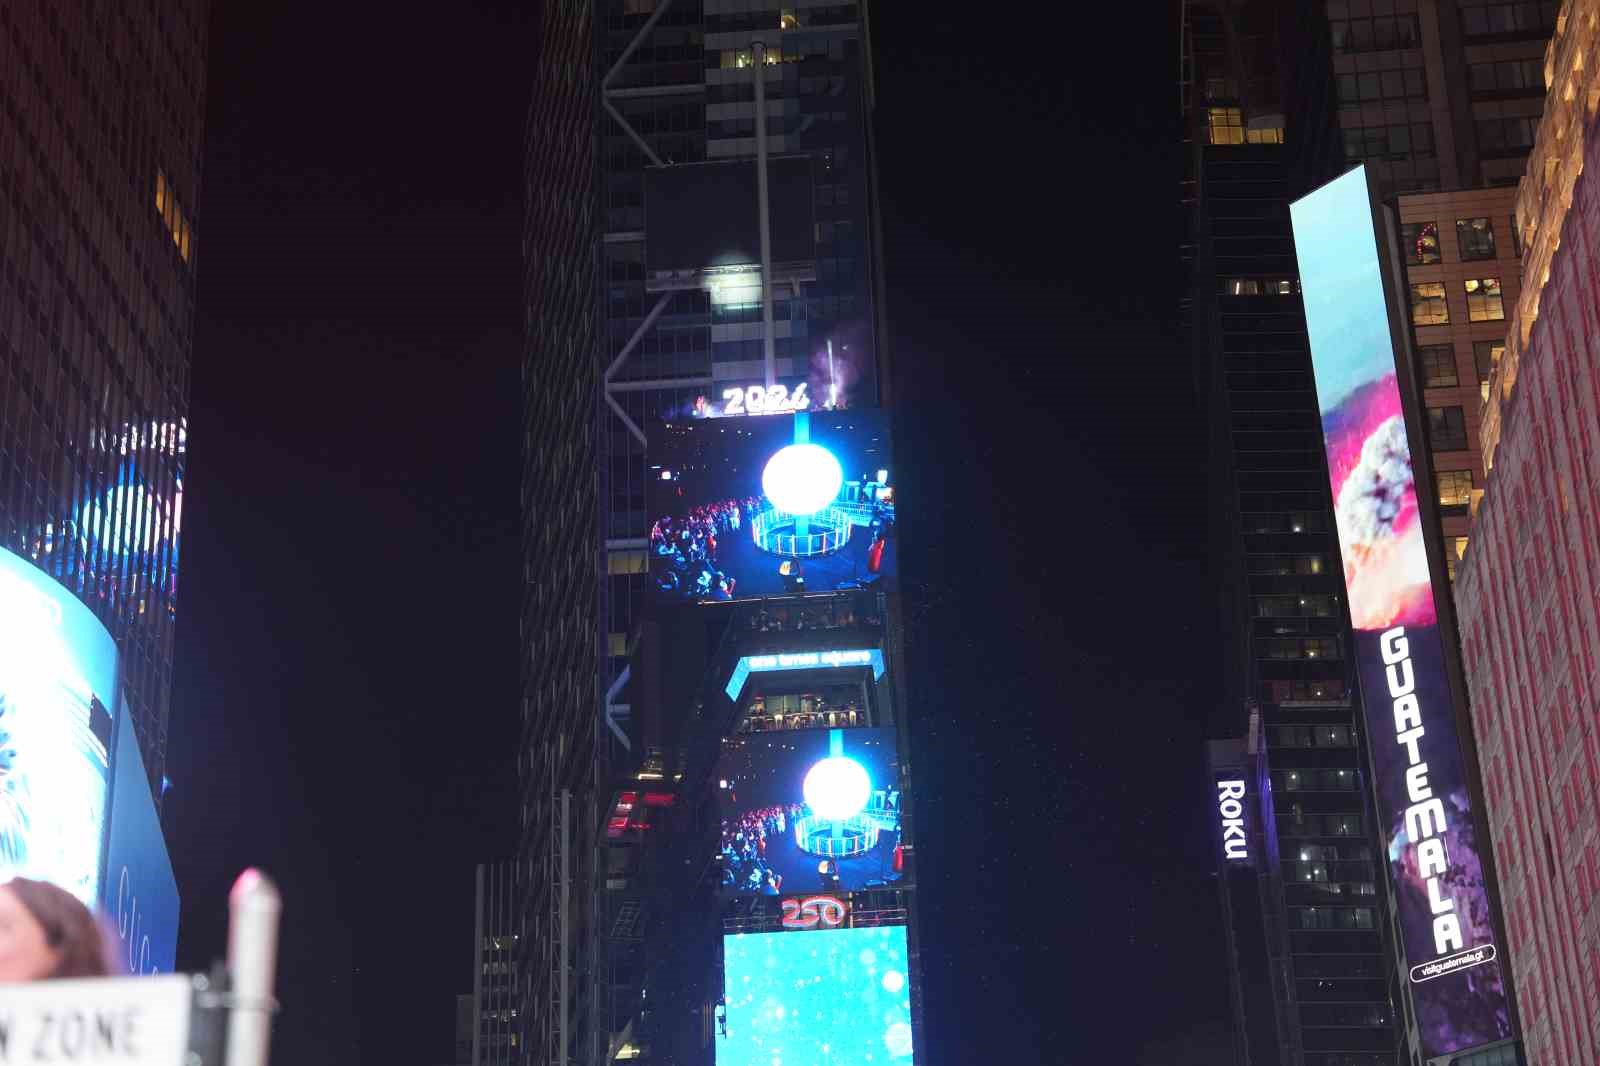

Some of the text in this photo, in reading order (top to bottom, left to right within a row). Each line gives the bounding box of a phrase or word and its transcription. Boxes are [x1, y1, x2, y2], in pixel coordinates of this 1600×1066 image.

[1380, 626, 1463, 954] GUATEMALA
[781, 896, 846, 928] 250
[31, 1006, 143, 1061] ZONE
